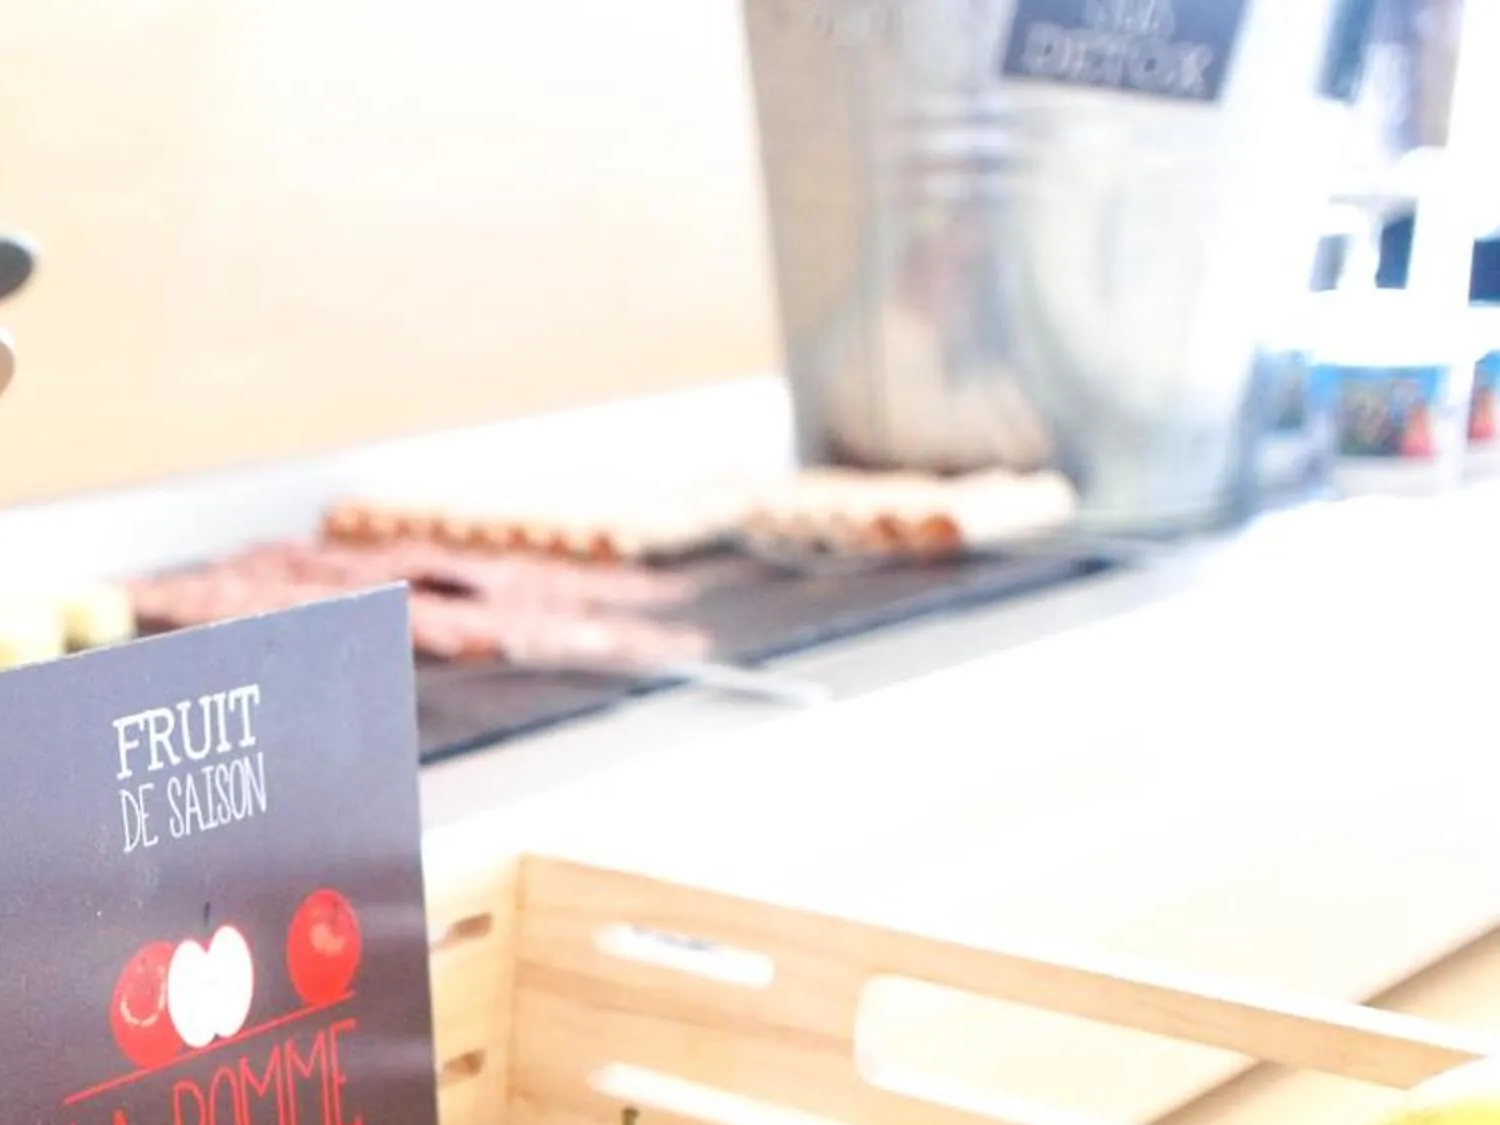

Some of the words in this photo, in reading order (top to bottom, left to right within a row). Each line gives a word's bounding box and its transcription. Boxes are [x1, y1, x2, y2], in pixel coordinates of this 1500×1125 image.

[112, 684, 260, 780] FRUIT
[119, 783, 159, 852] DE
[169, 752, 267, 838] SAISON
